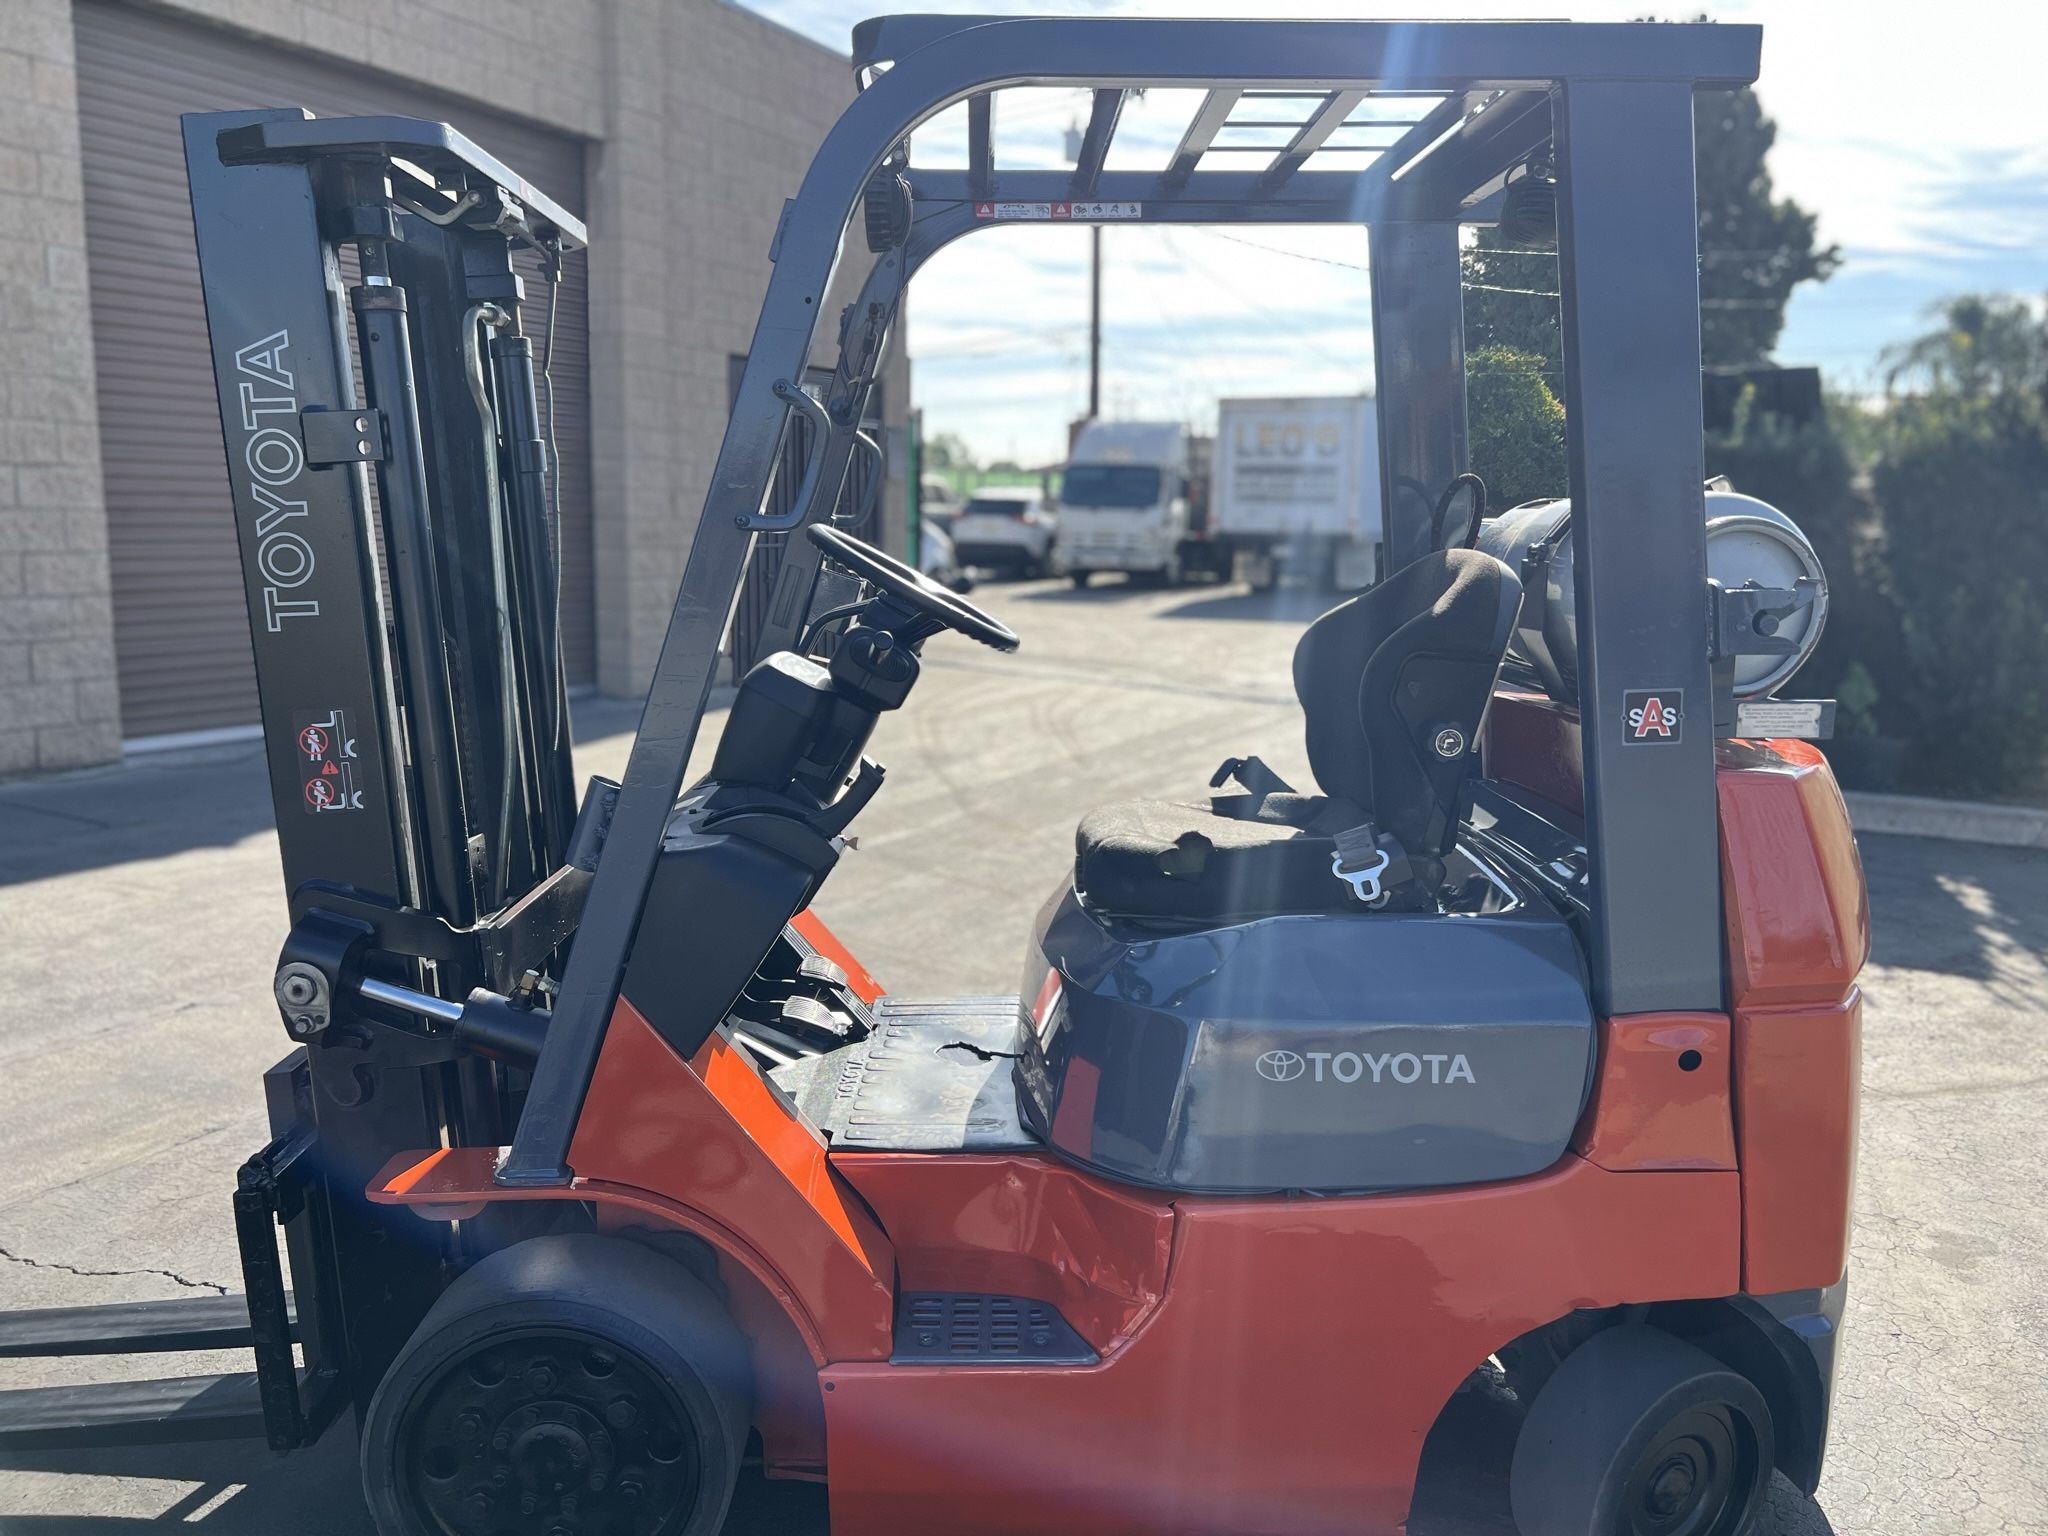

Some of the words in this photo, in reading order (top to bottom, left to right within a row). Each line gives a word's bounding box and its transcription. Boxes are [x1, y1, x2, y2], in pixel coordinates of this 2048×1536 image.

[235, 329, 320, 632] TOYOTA
[1628, 697, 1677, 738] SAS
[1306, 1051, 1477, 1084] TOYOTA
